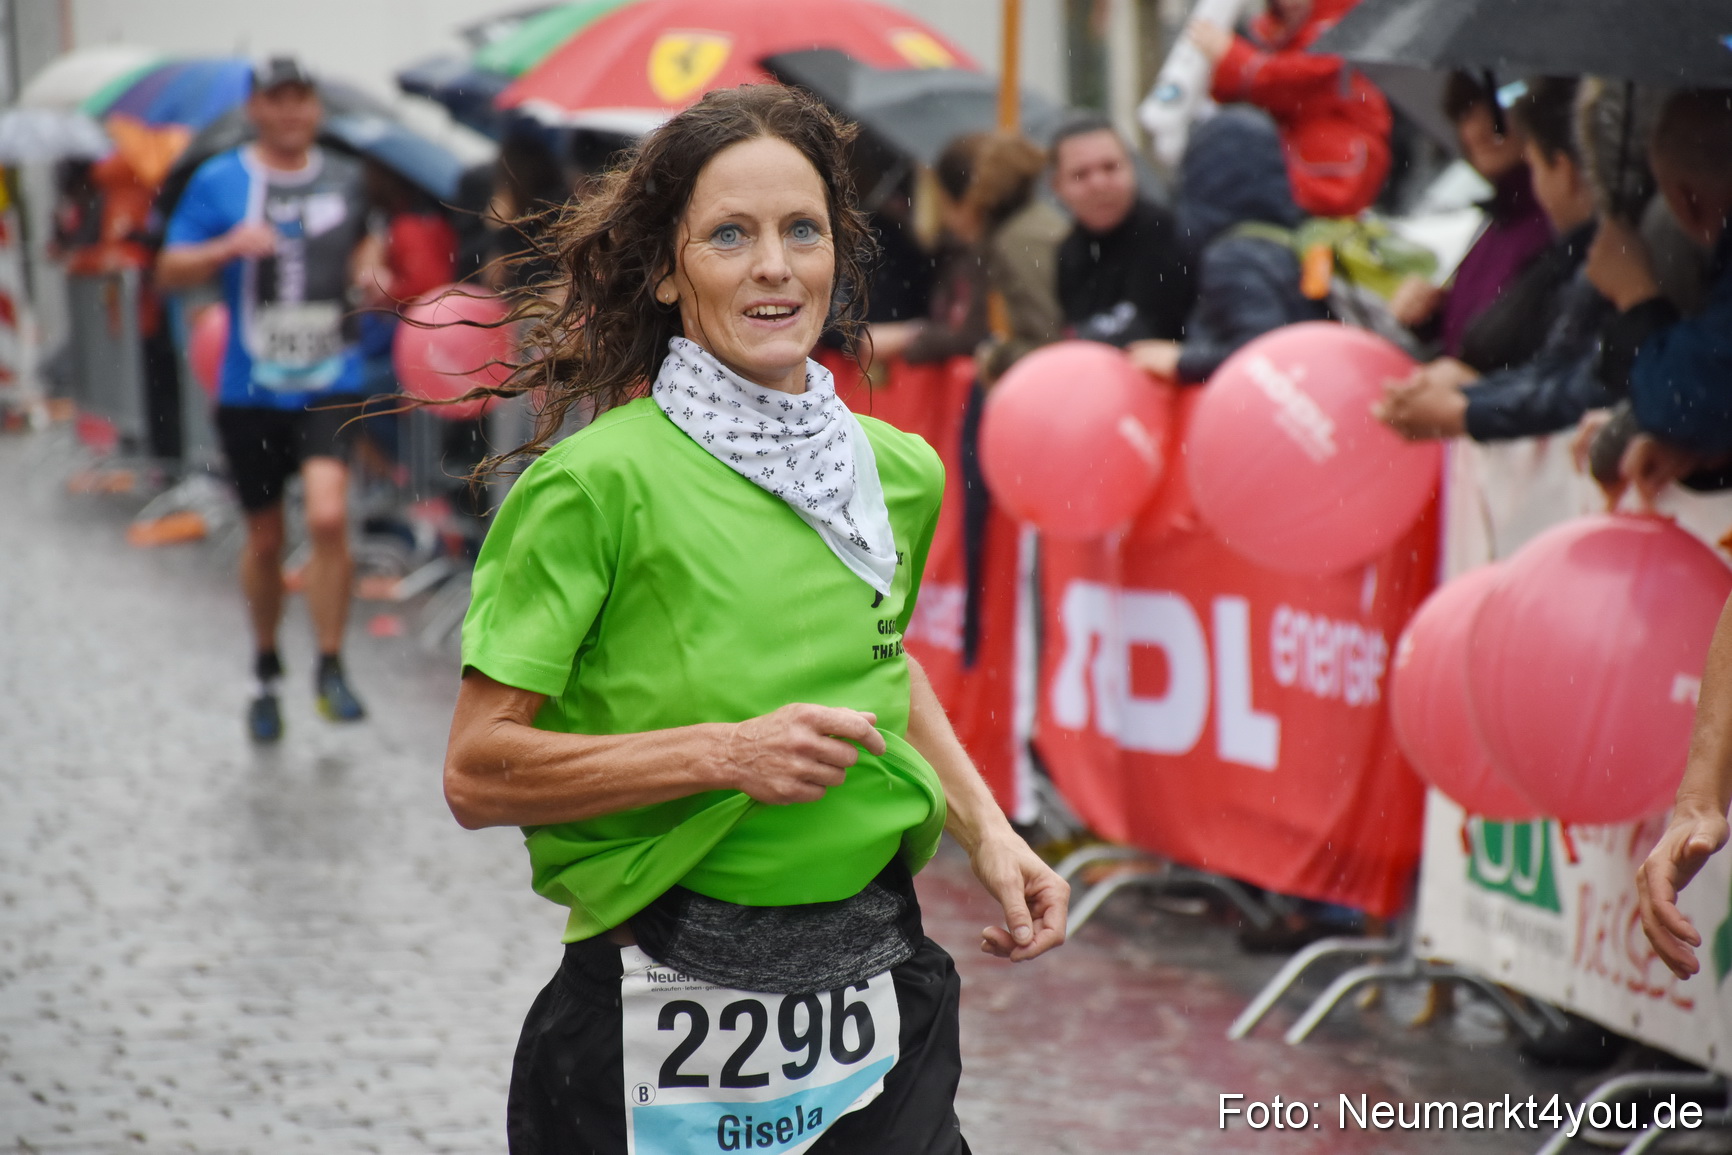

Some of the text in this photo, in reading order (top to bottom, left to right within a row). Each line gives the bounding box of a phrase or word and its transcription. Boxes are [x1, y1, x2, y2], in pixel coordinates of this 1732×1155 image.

[872, 642, 893, 660] THE
[657, 979, 876, 1089] 2296
[639, 1086, 649, 1102] B
[717, 1105, 824, 1151] Gisela
